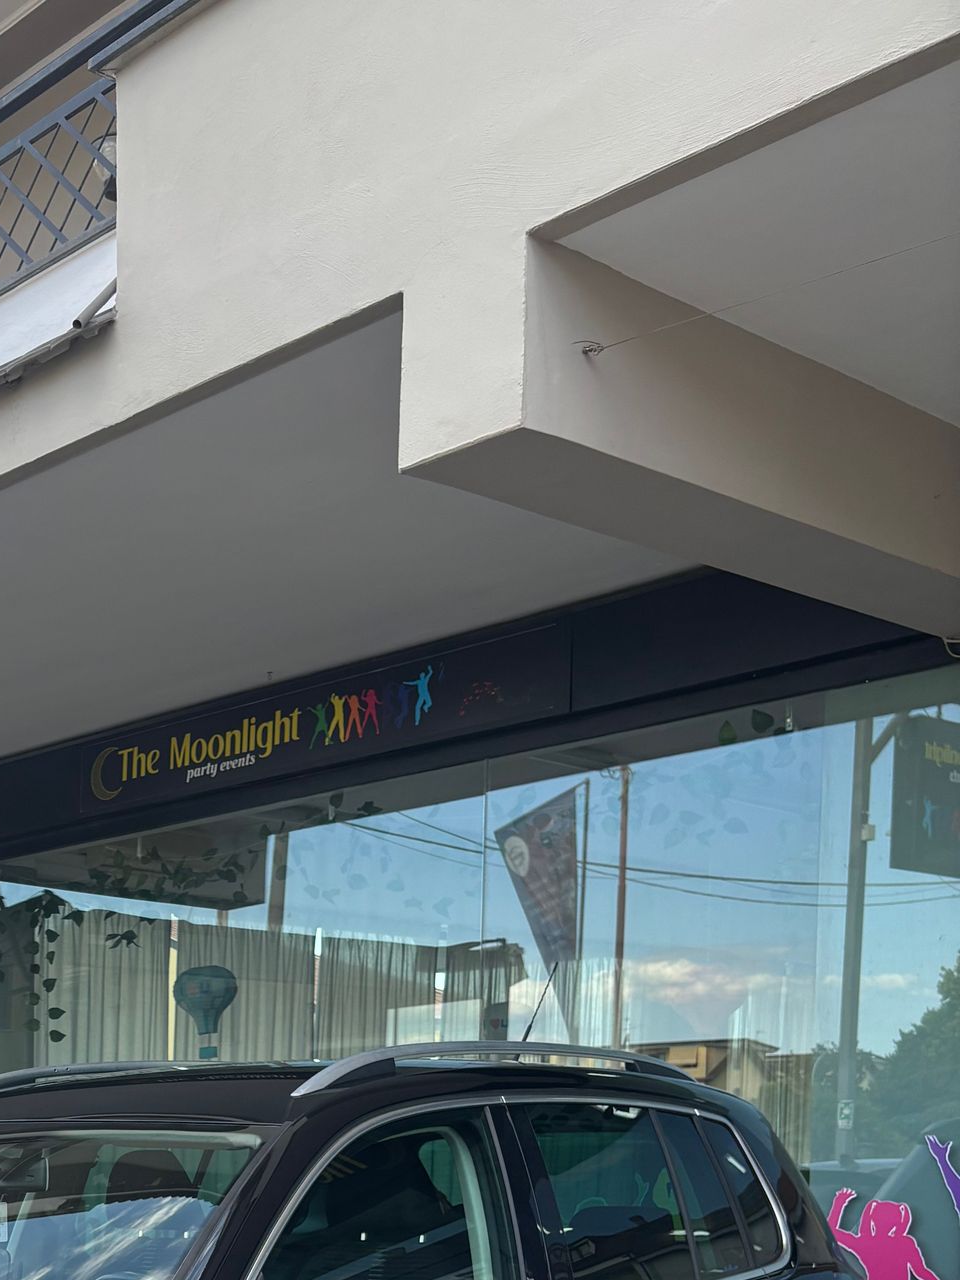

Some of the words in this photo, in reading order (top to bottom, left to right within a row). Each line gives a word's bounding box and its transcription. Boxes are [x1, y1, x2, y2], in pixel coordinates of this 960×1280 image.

[118, 746, 160, 782] The
[169, 708, 302, 770] Moonlight
[186, 761, 218, 783] party
[220, 753, 256, 772] events
